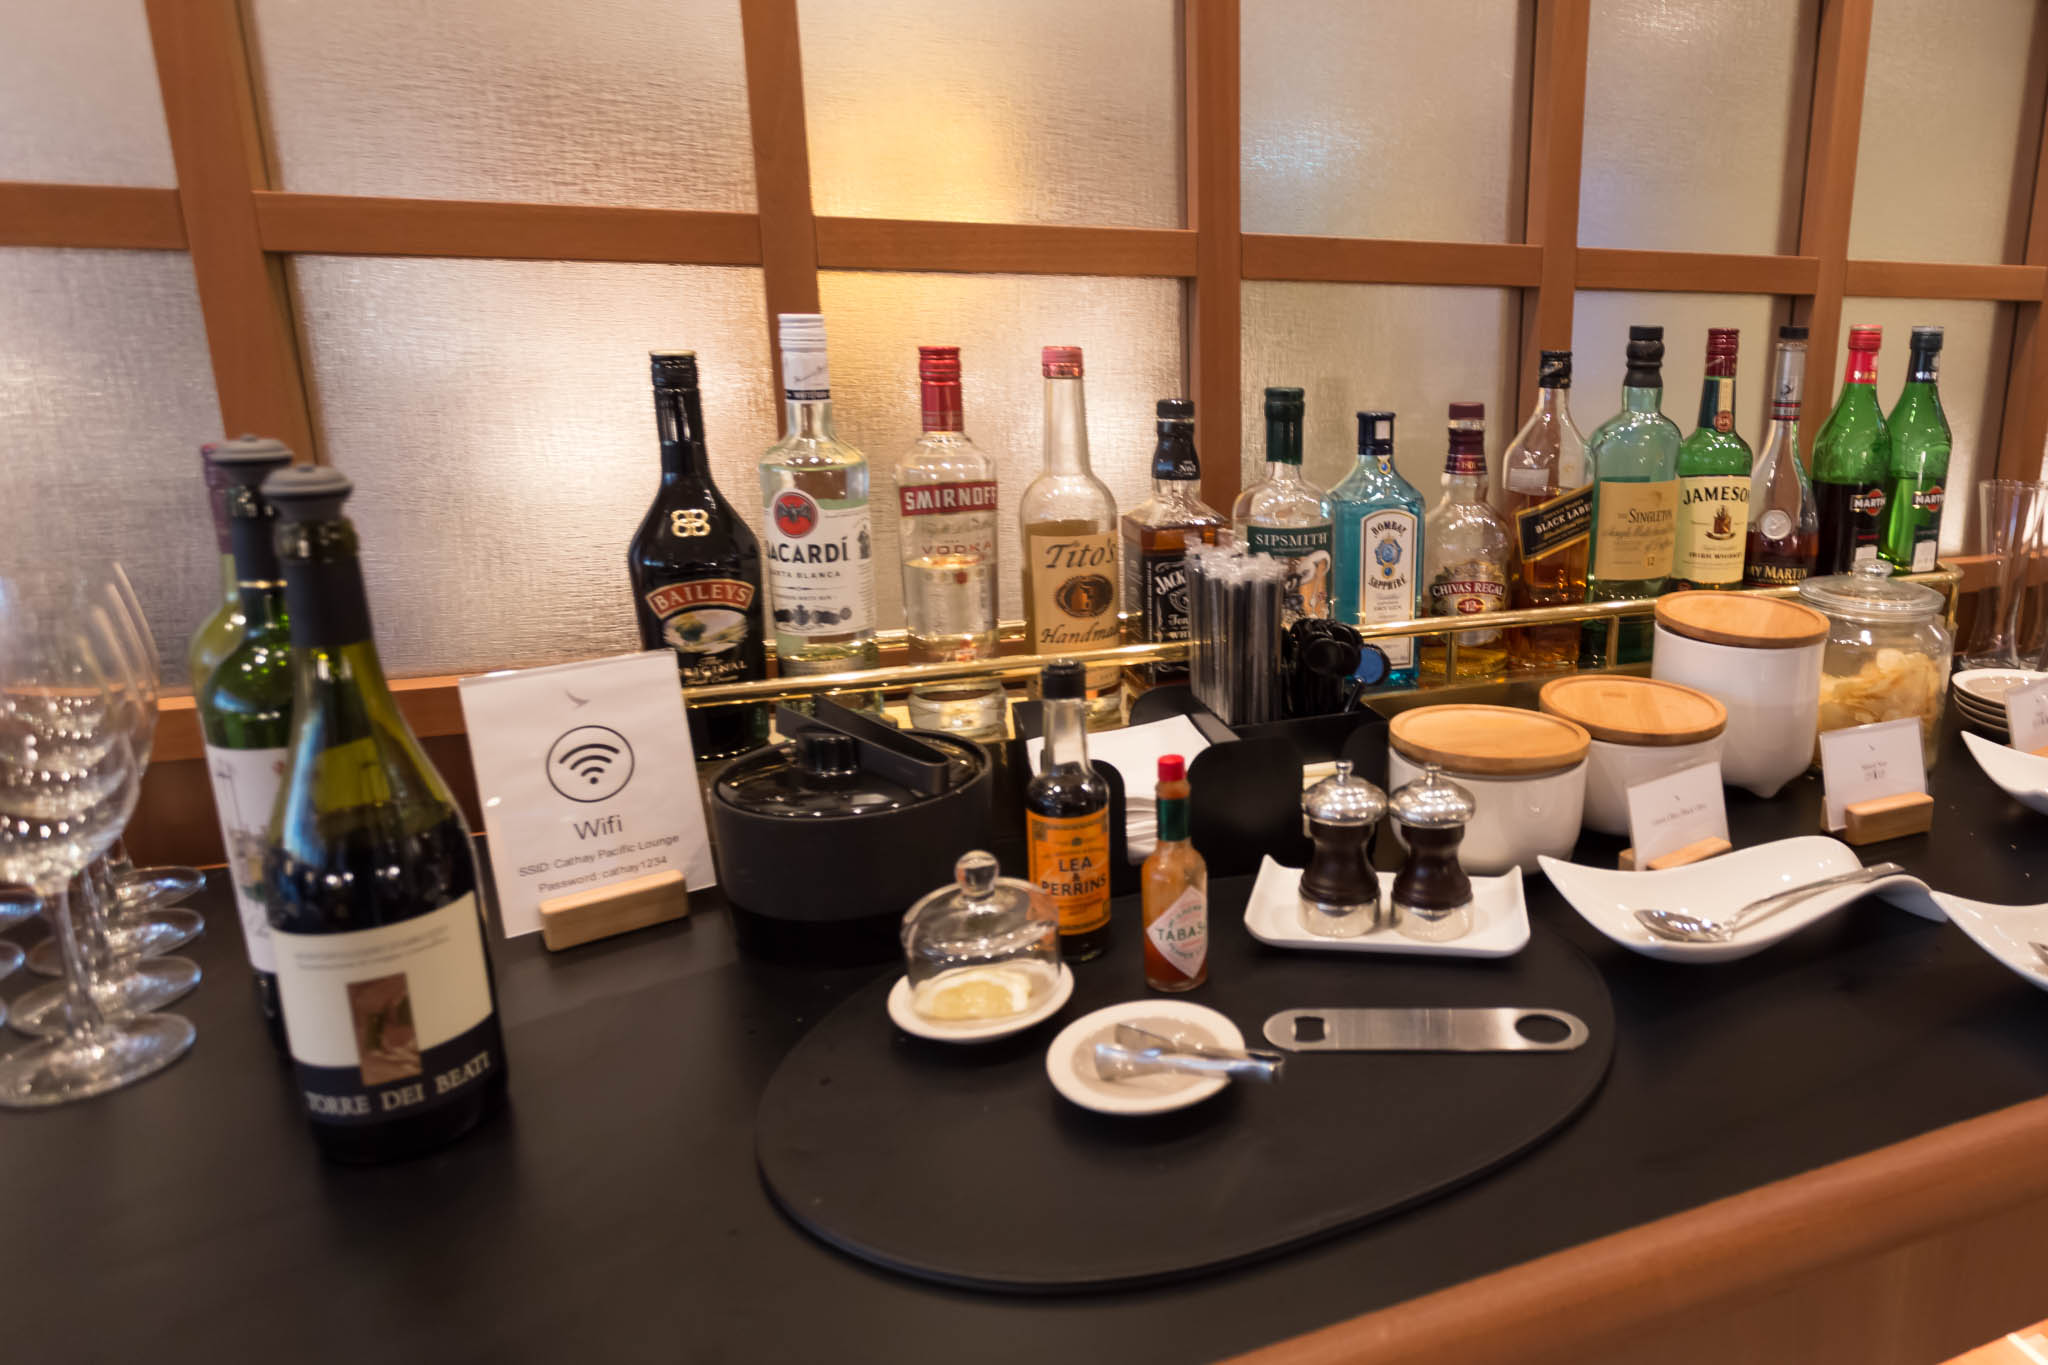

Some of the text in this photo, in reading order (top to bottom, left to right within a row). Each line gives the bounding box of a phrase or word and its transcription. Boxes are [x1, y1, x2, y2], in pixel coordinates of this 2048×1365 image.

[904, 486, 997, 511] SMIRNOFF
[1535, 514, 1566, 535] BLACK
[766, 535, 849, 563] ACARDÍ
[1255, 531, 1328, 547] SIPSMITH
[1045, 537, 1117, 569] Tito's
[1154, 570, 1186, 595] JACK
[1432, 582, 1503, 597] CHIVAS REGAL
[653, 583, 747, 611] BAILEYS
[573, 814, 624, 840] Wifi
[553, 853, 596, 871] Cathay
[599, 842, 636, 860] Pacific
[638, 834, 680, 852] Lounge
[1058, 856, 1092, 873] LEA
[1041, 872, 1106, 897] PERRINS
[380, 1083, 425, 1111] DEI
[434, 1051, 490, 1095] BEATI
